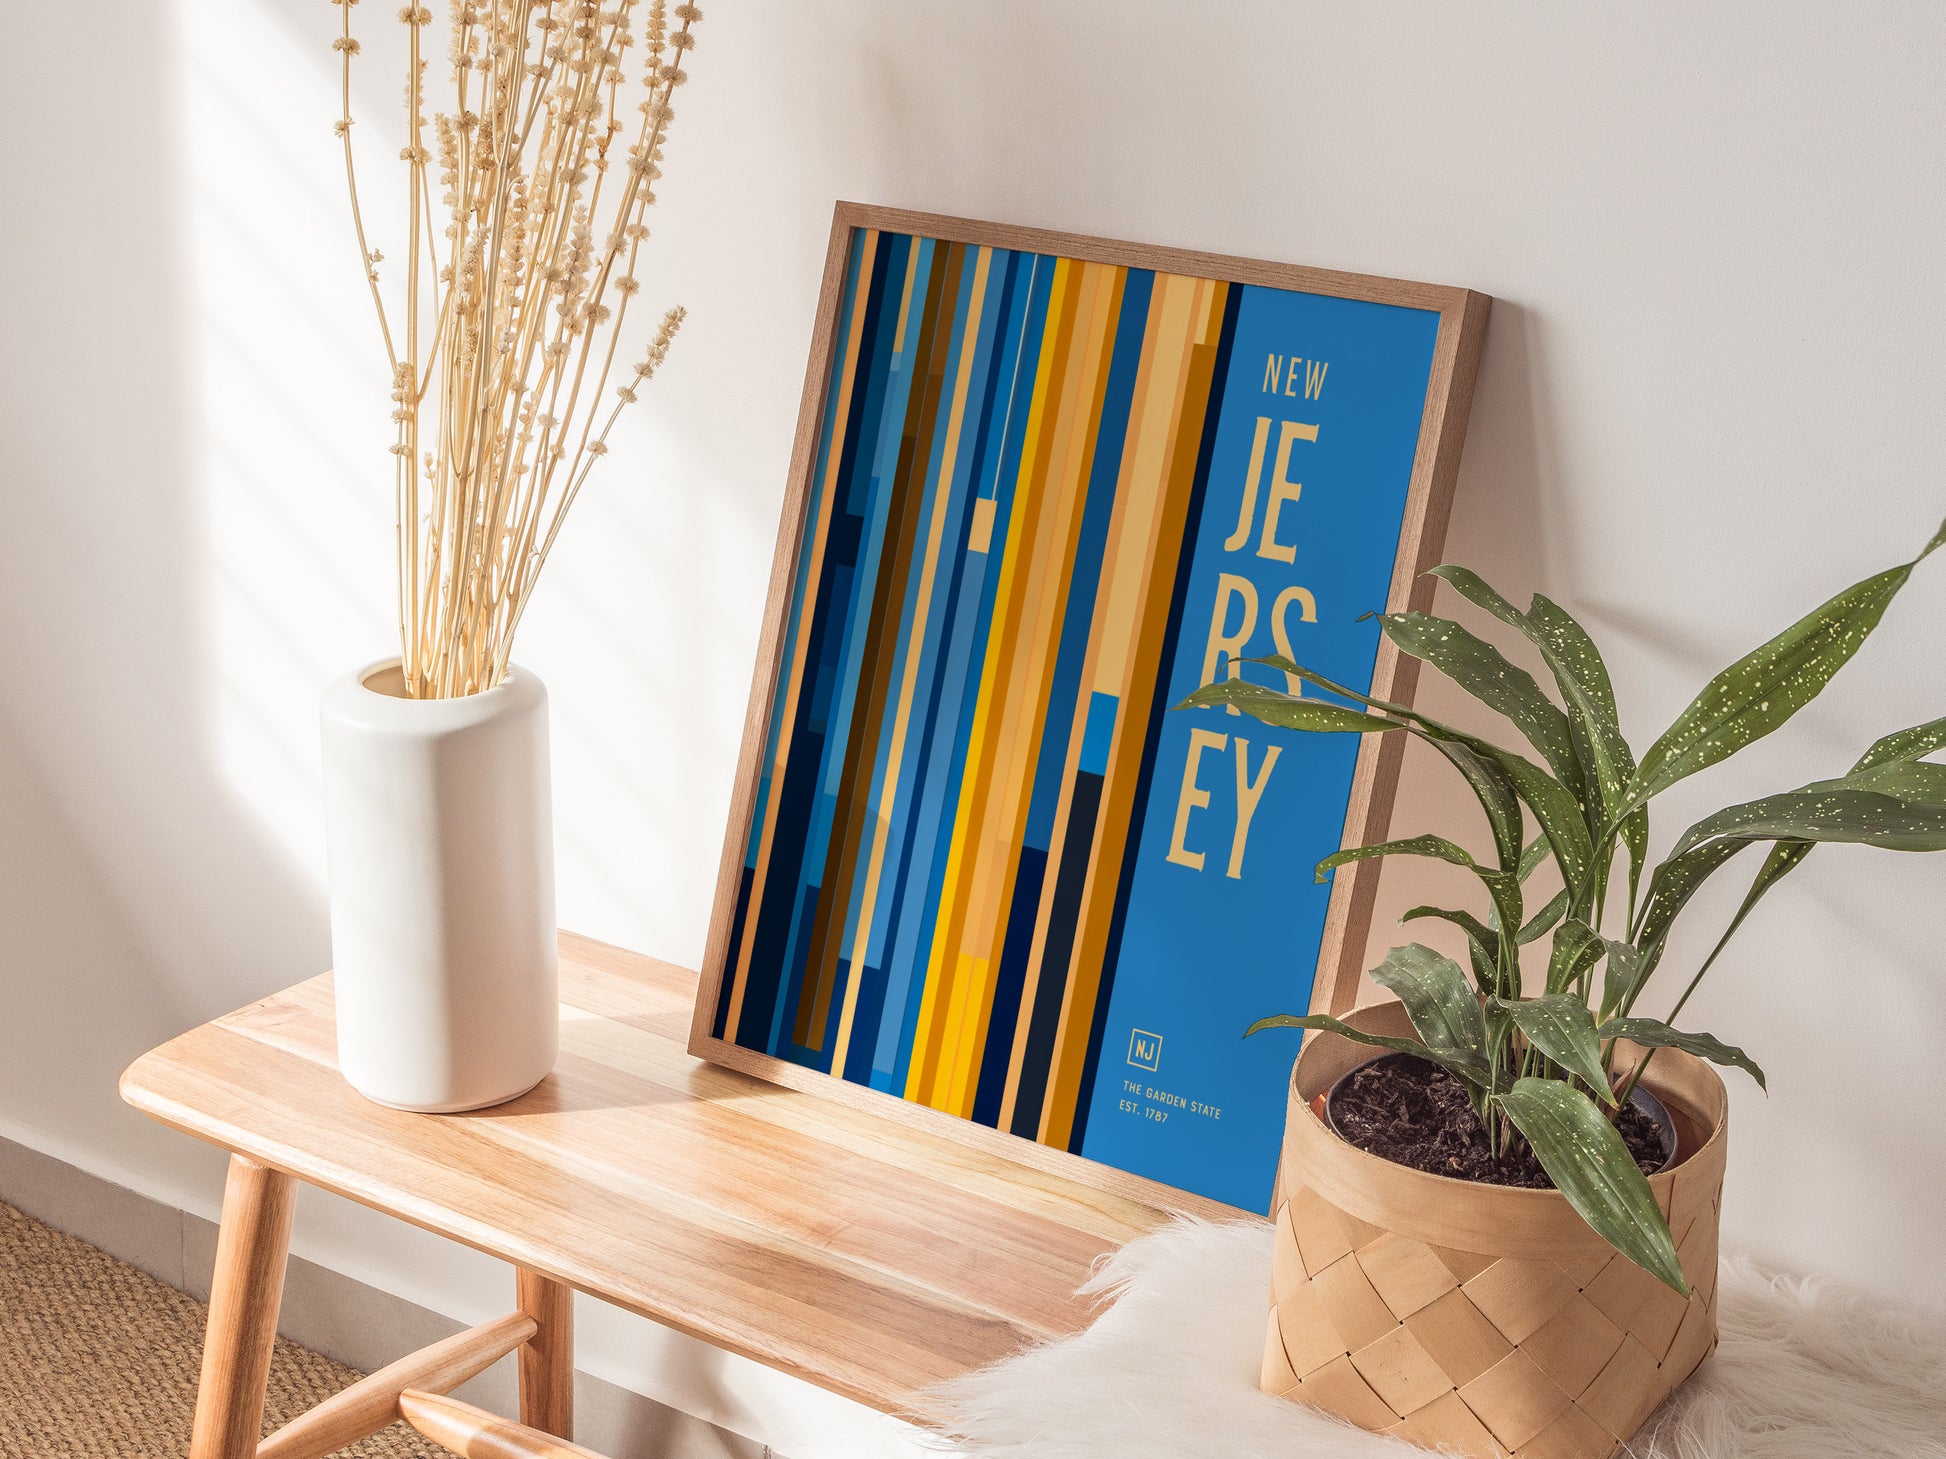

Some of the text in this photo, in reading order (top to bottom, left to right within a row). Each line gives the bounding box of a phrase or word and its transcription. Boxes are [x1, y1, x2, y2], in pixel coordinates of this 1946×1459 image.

[1262, 353, 1329, 400] NEW
[1224, 416, 1319, 564] JE
[1166, 728, 1283, 879] EY
[1135, 1039, 1154, 1060] NJ
[1119, 1099, 1168, 1123] EST. 1787
[1123, 1080, 1221, 1120] THE GARDEN STATE
